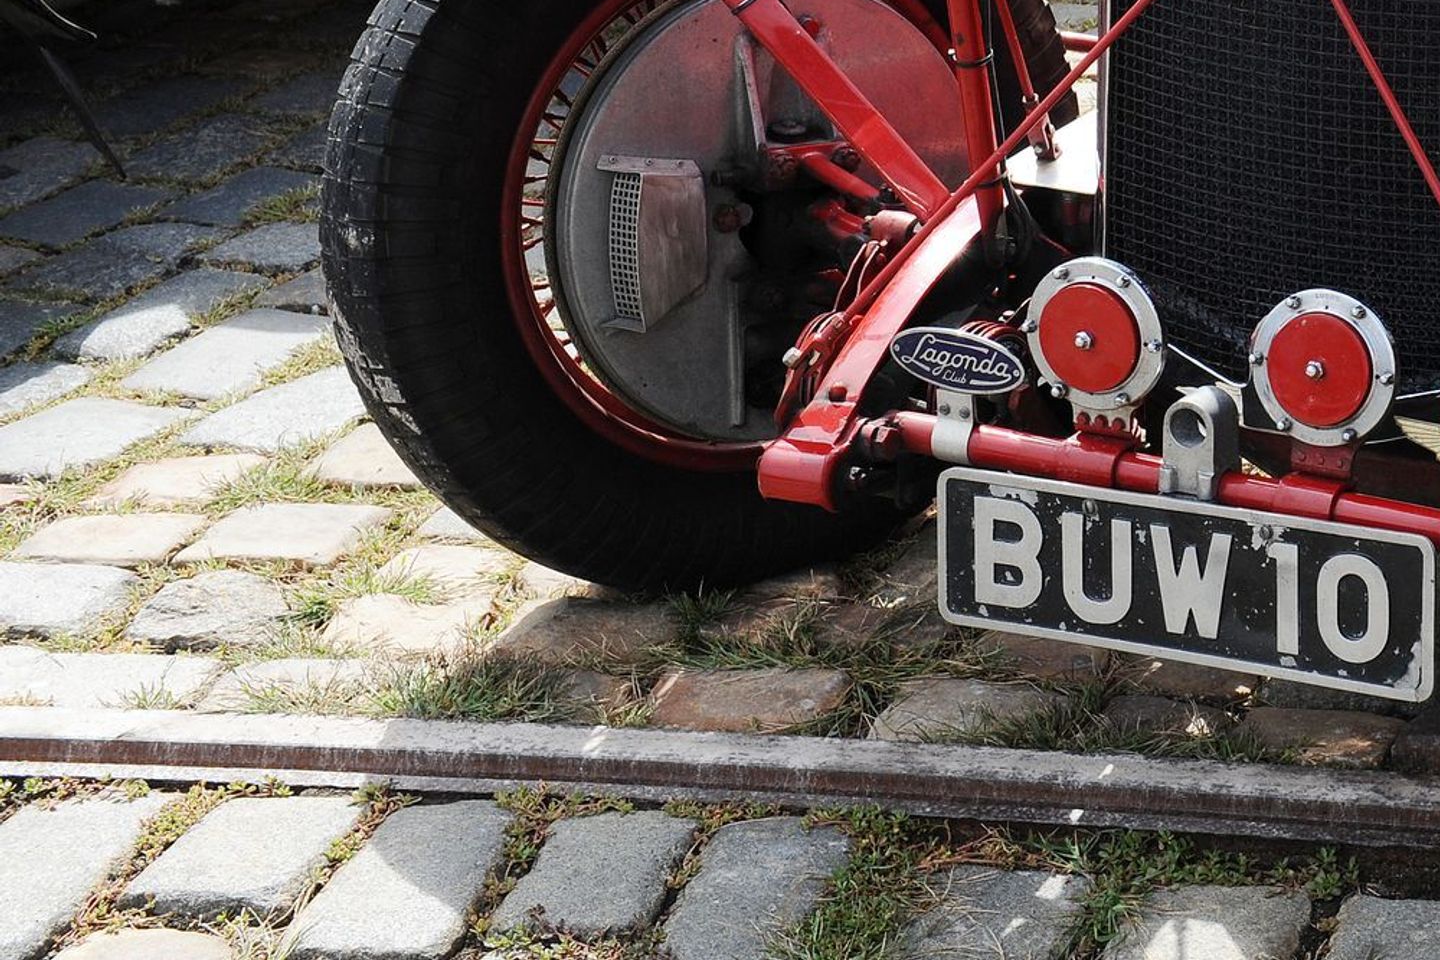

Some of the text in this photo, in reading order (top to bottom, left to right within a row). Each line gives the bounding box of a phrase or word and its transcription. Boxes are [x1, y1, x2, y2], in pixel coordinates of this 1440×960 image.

[901, 334, 1012, 386] Lagonda
[942, 370, 967, 384] Club
[973, 495, 1390, 664] BUW 10
